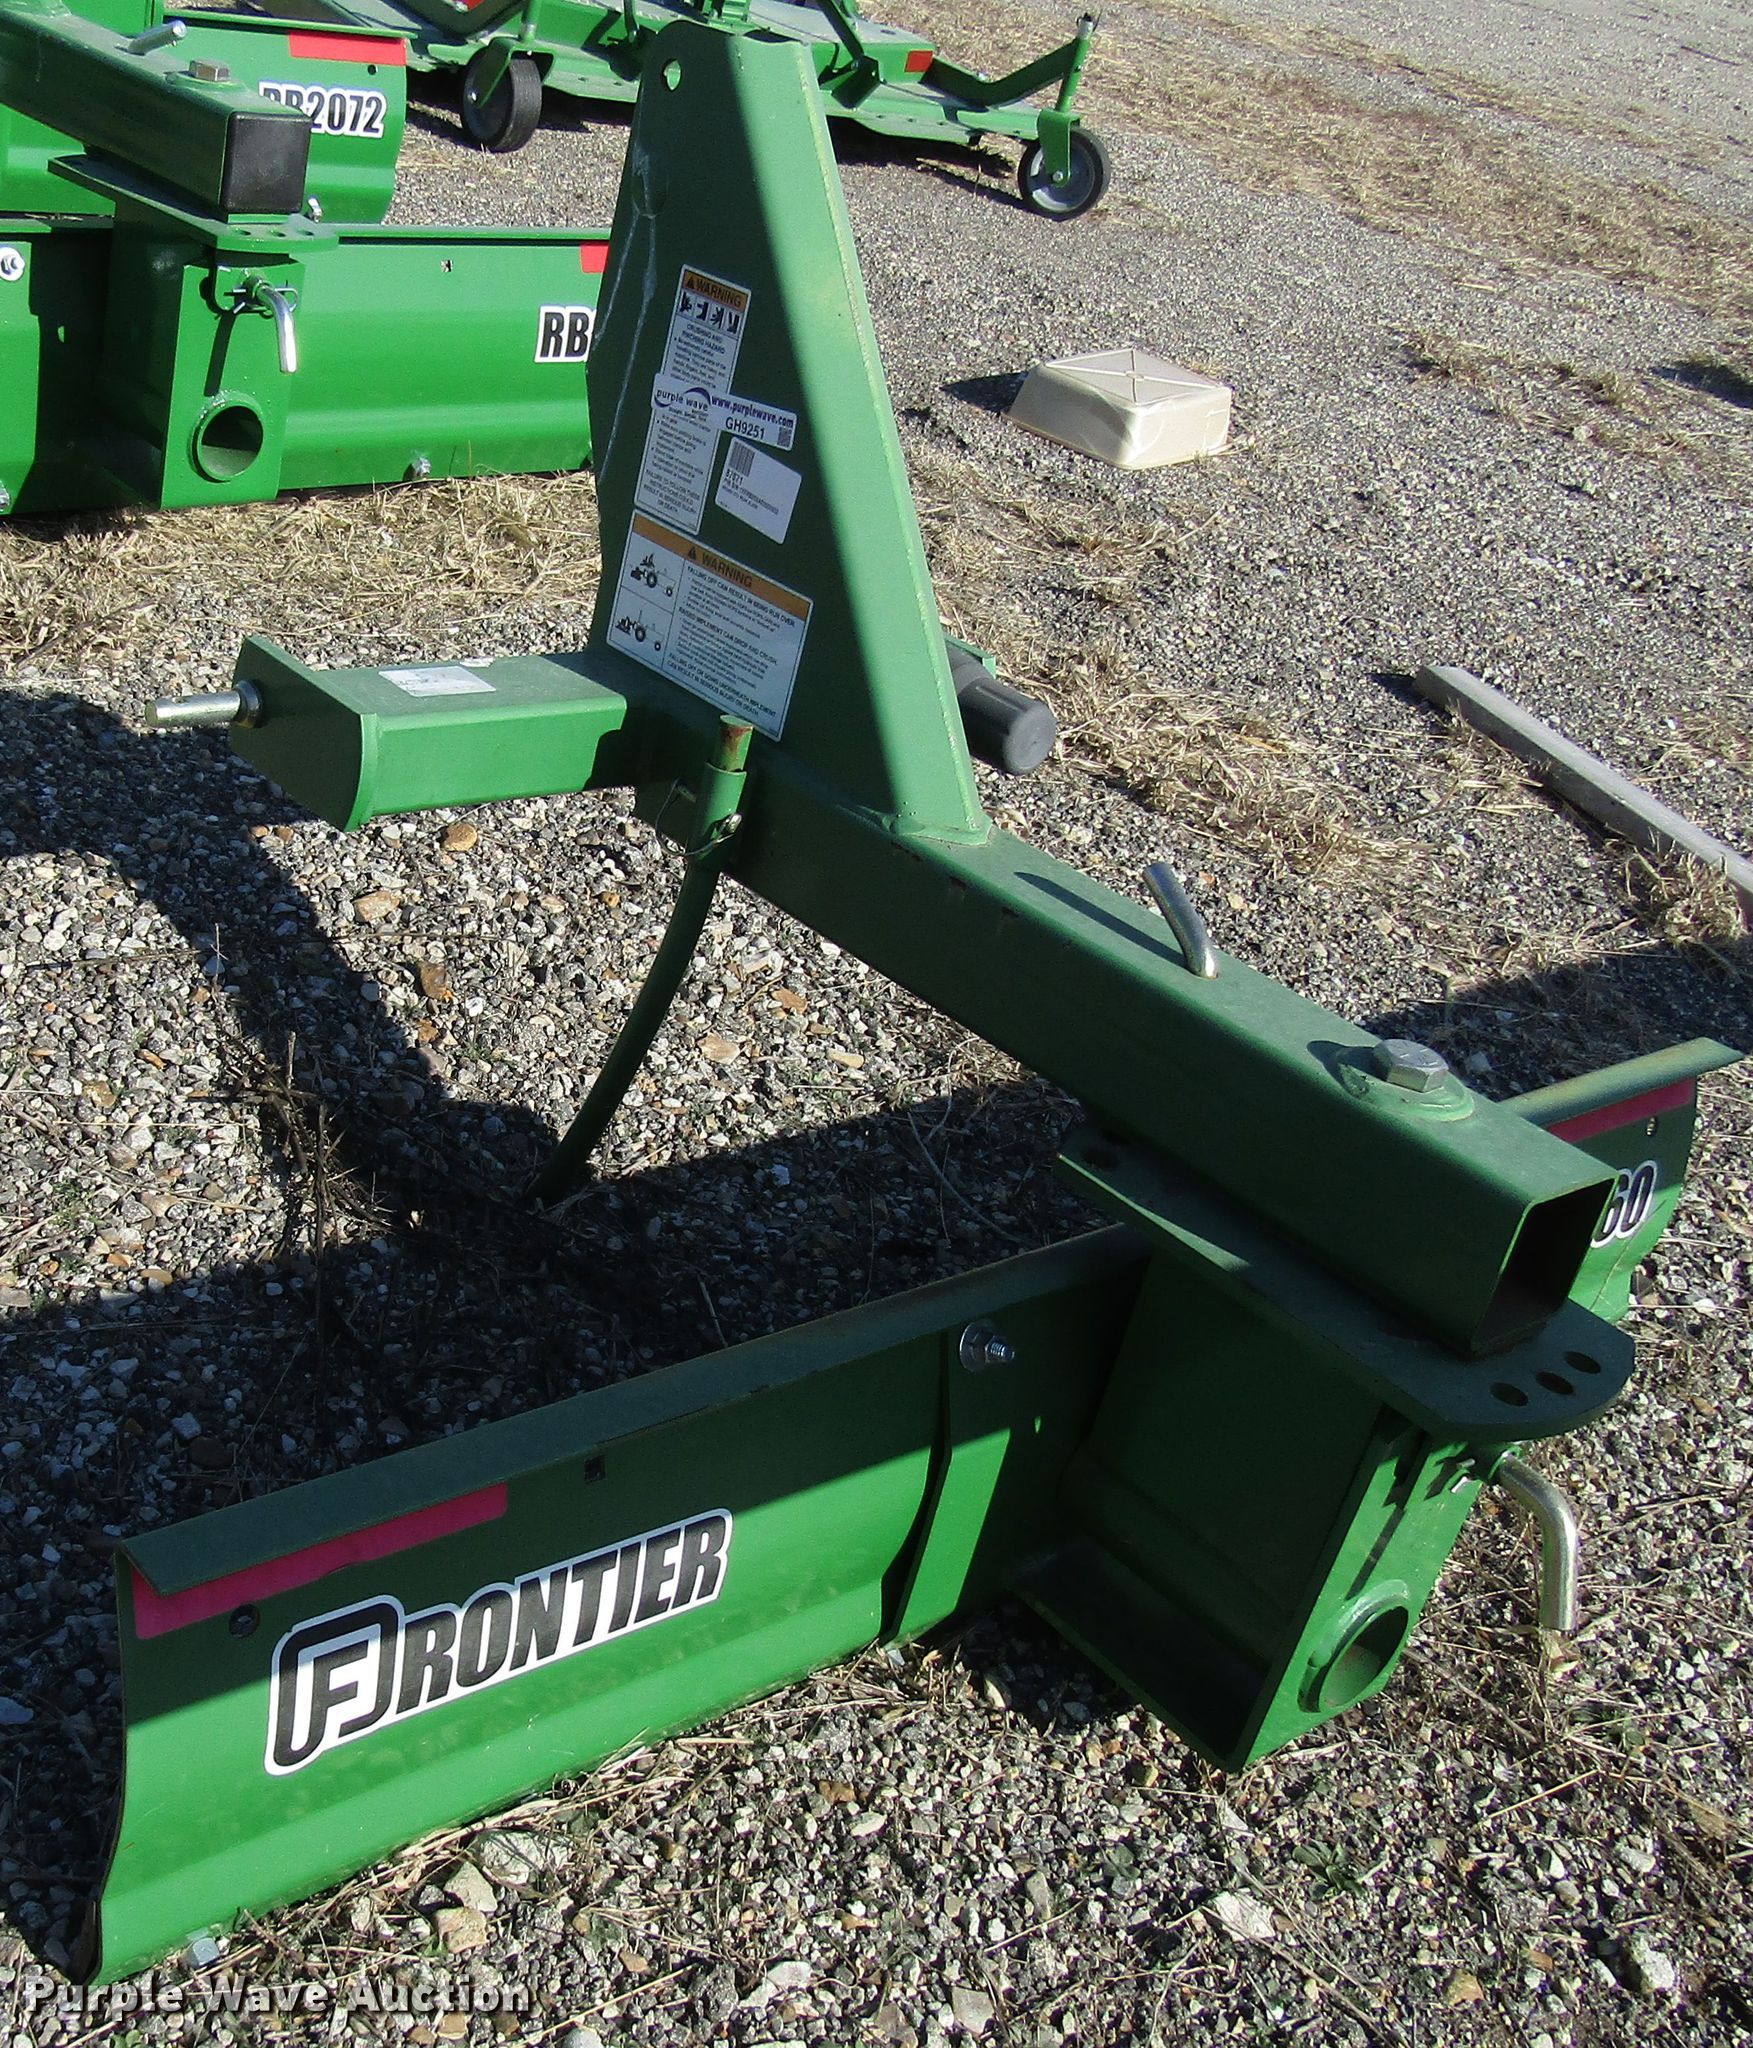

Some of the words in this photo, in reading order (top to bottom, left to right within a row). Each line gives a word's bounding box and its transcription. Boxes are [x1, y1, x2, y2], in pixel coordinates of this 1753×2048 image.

[696, 280, 741, 306] WARNING
[656, 388, 683, 404] purple
[686, 398, 707, 411] wave
[712, 396, 792, 427] www.purplewave.com
[725, 417, 764, 438] GH9251
[701, 553, 752, 587] WARNING
[717, 581, 728, 591] CAN
[270, 1511, 731, 1770] FRONTIER
